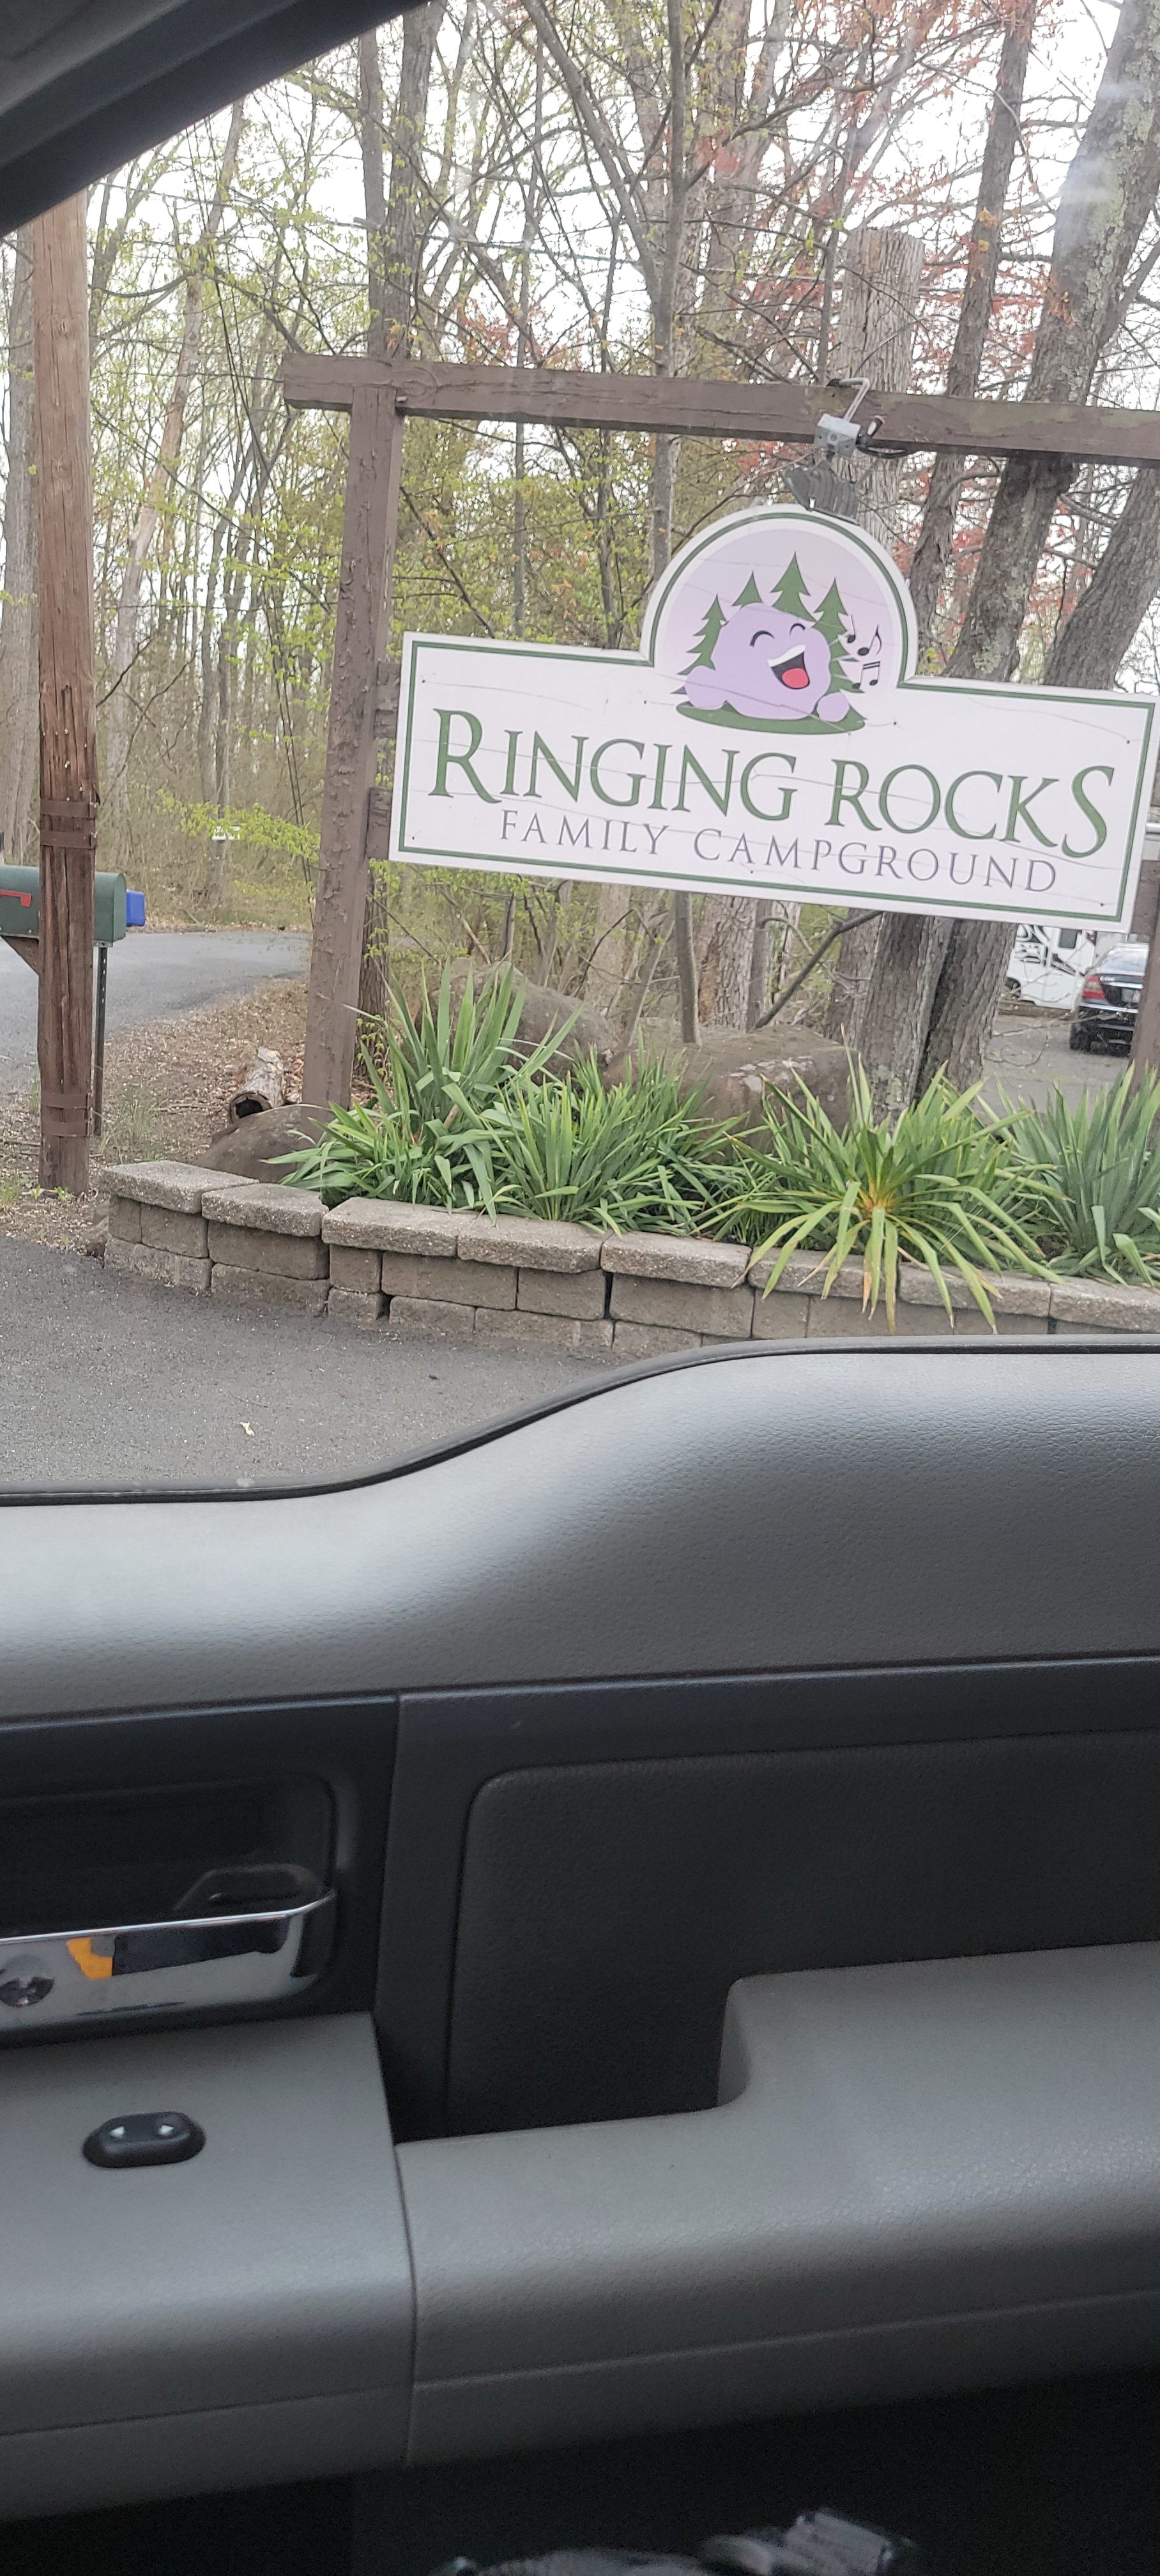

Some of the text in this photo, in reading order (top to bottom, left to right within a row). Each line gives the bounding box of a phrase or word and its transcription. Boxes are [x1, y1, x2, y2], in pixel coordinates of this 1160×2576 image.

[427, 708, 1115, 858] RINGING ROCKS
[499, 809, 1057, 893] FAMILY CAMPGROUND
